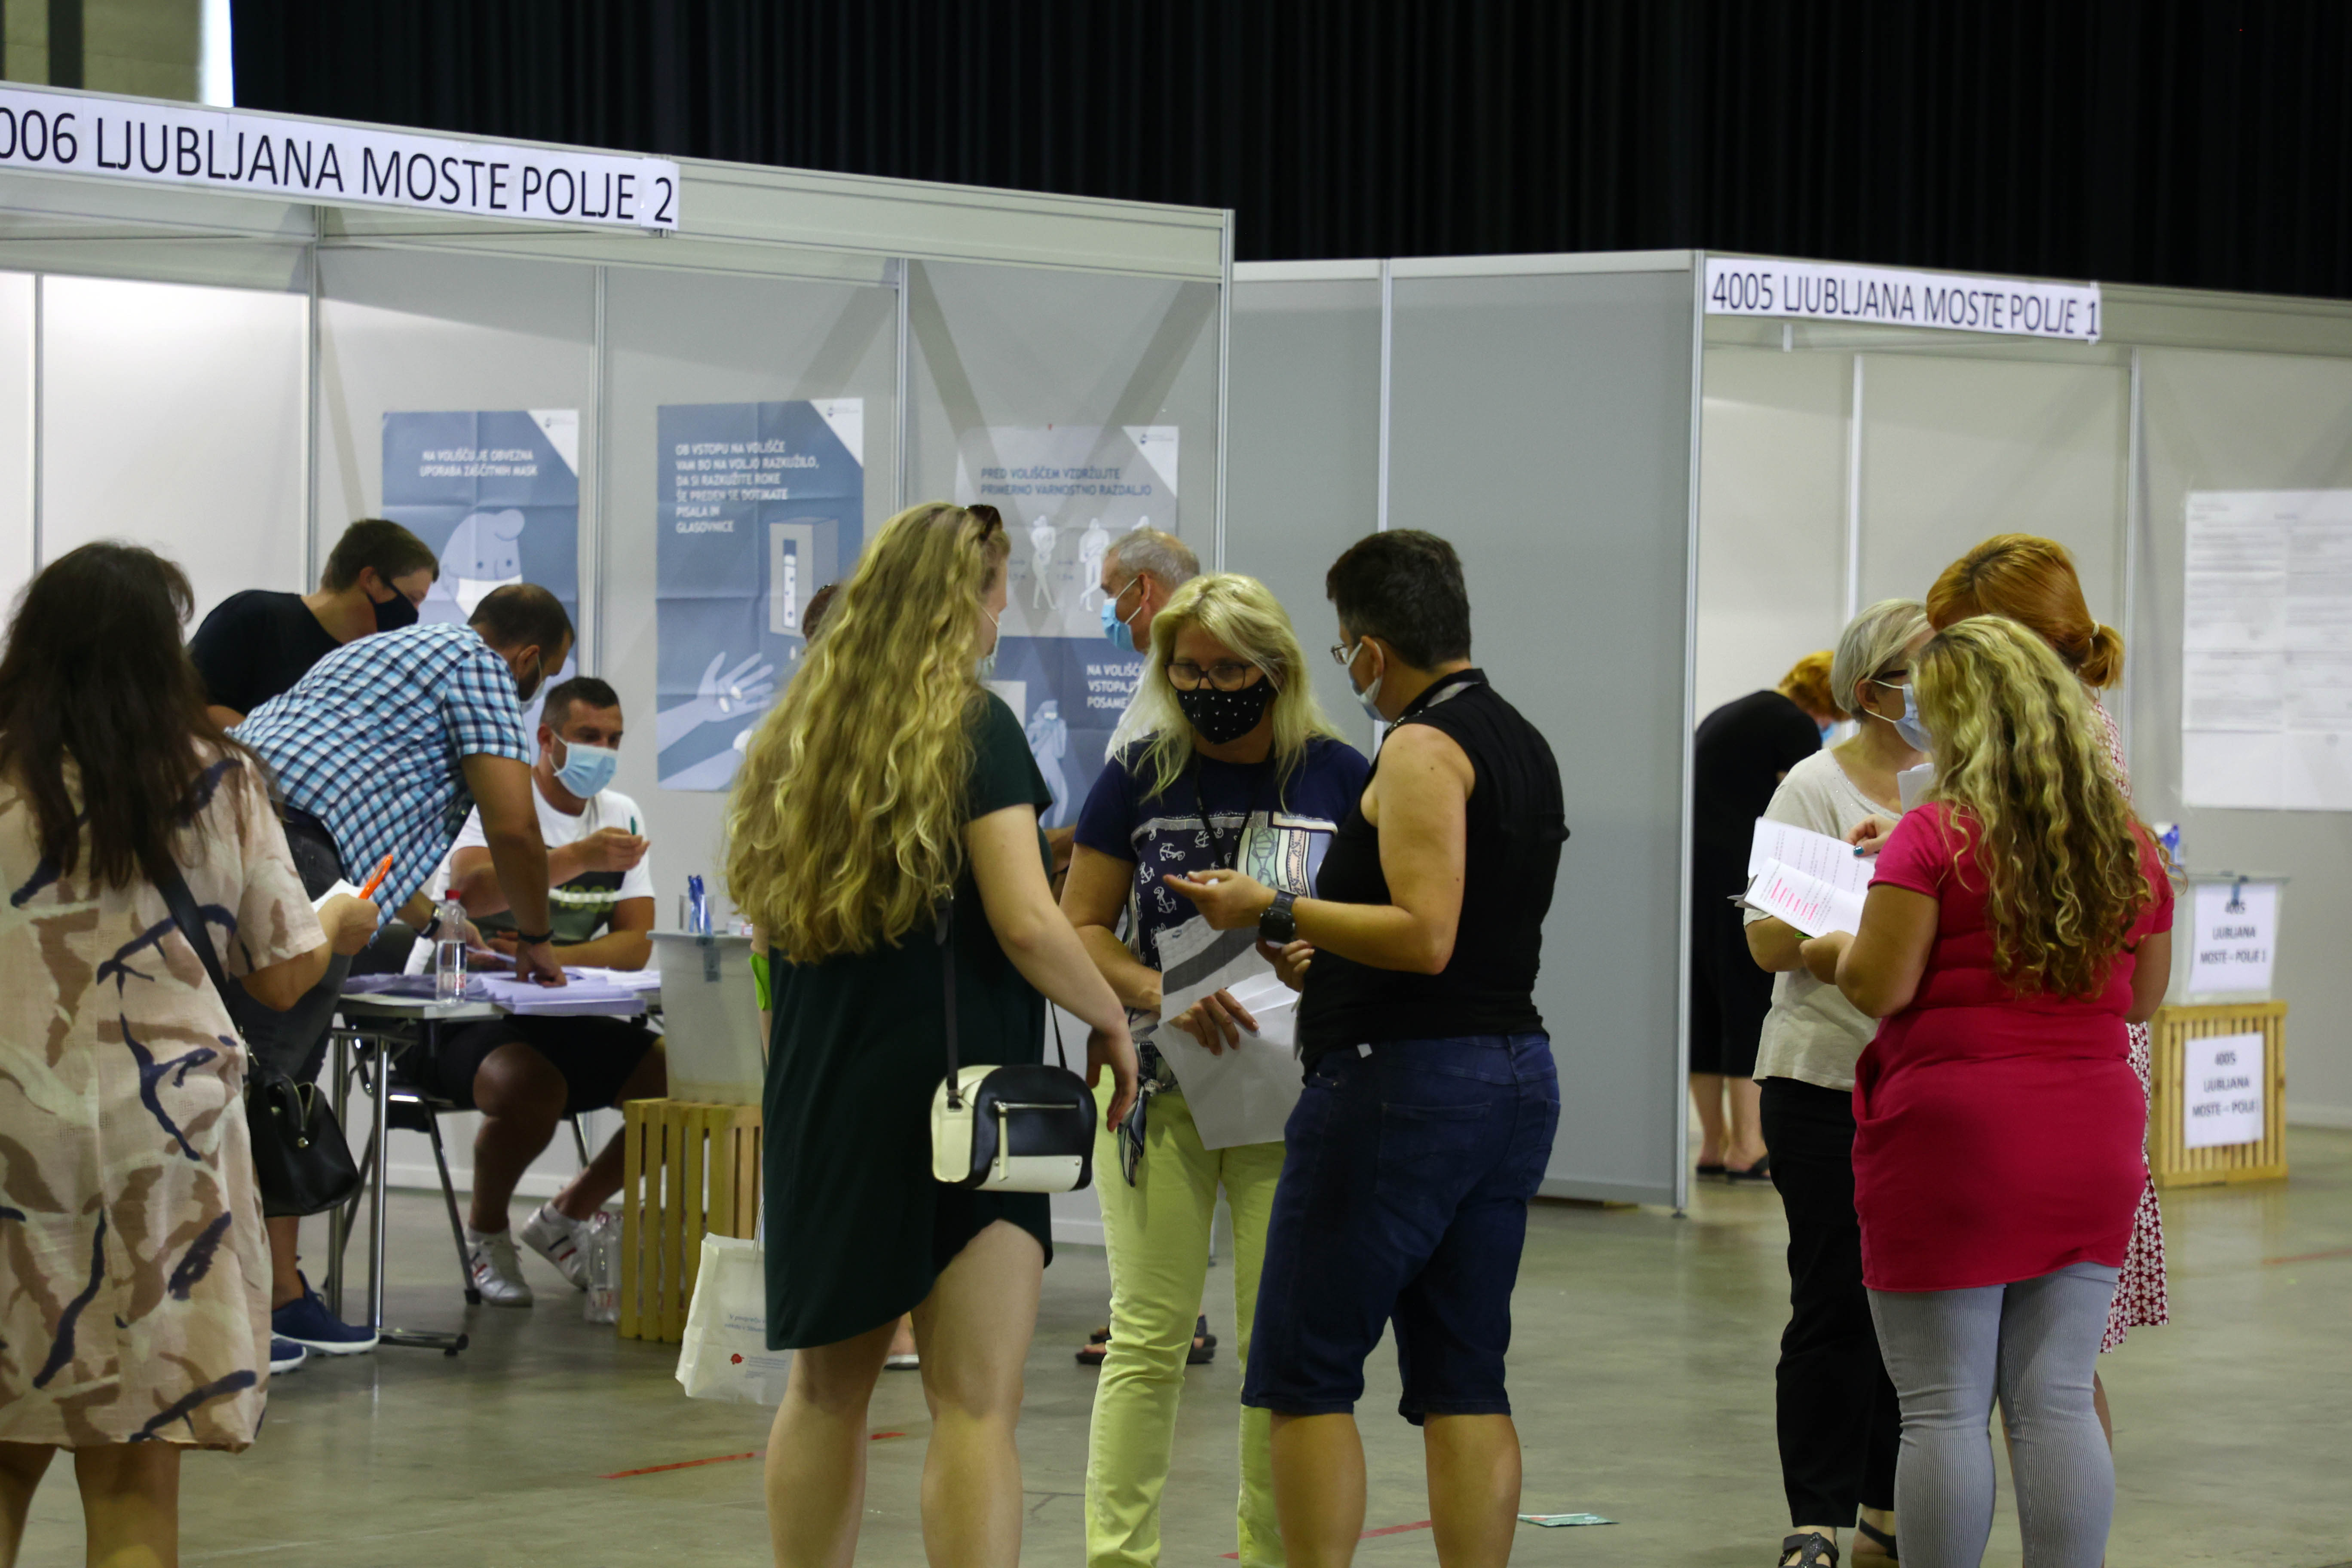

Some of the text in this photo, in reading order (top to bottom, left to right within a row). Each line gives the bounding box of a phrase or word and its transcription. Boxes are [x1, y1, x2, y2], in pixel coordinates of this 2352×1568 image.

[97, 117, 344, 192] LJUBLJANA
[362, 147, 509, 209] MOSTE
[523, 166, 635, 220] POLJE
[654, 177, 672, 223] 2
[1712, 273, 2098, 335] 4005 LJUBLJANA MOSTE POLJE 1
[1087, 665, 1102, 676] NA
[2200, 950, 2226, 964] MOSTE
[2236, 949, 2259, 963] POLJE
[2193, 1102, 2221, 1118] MOSTE
